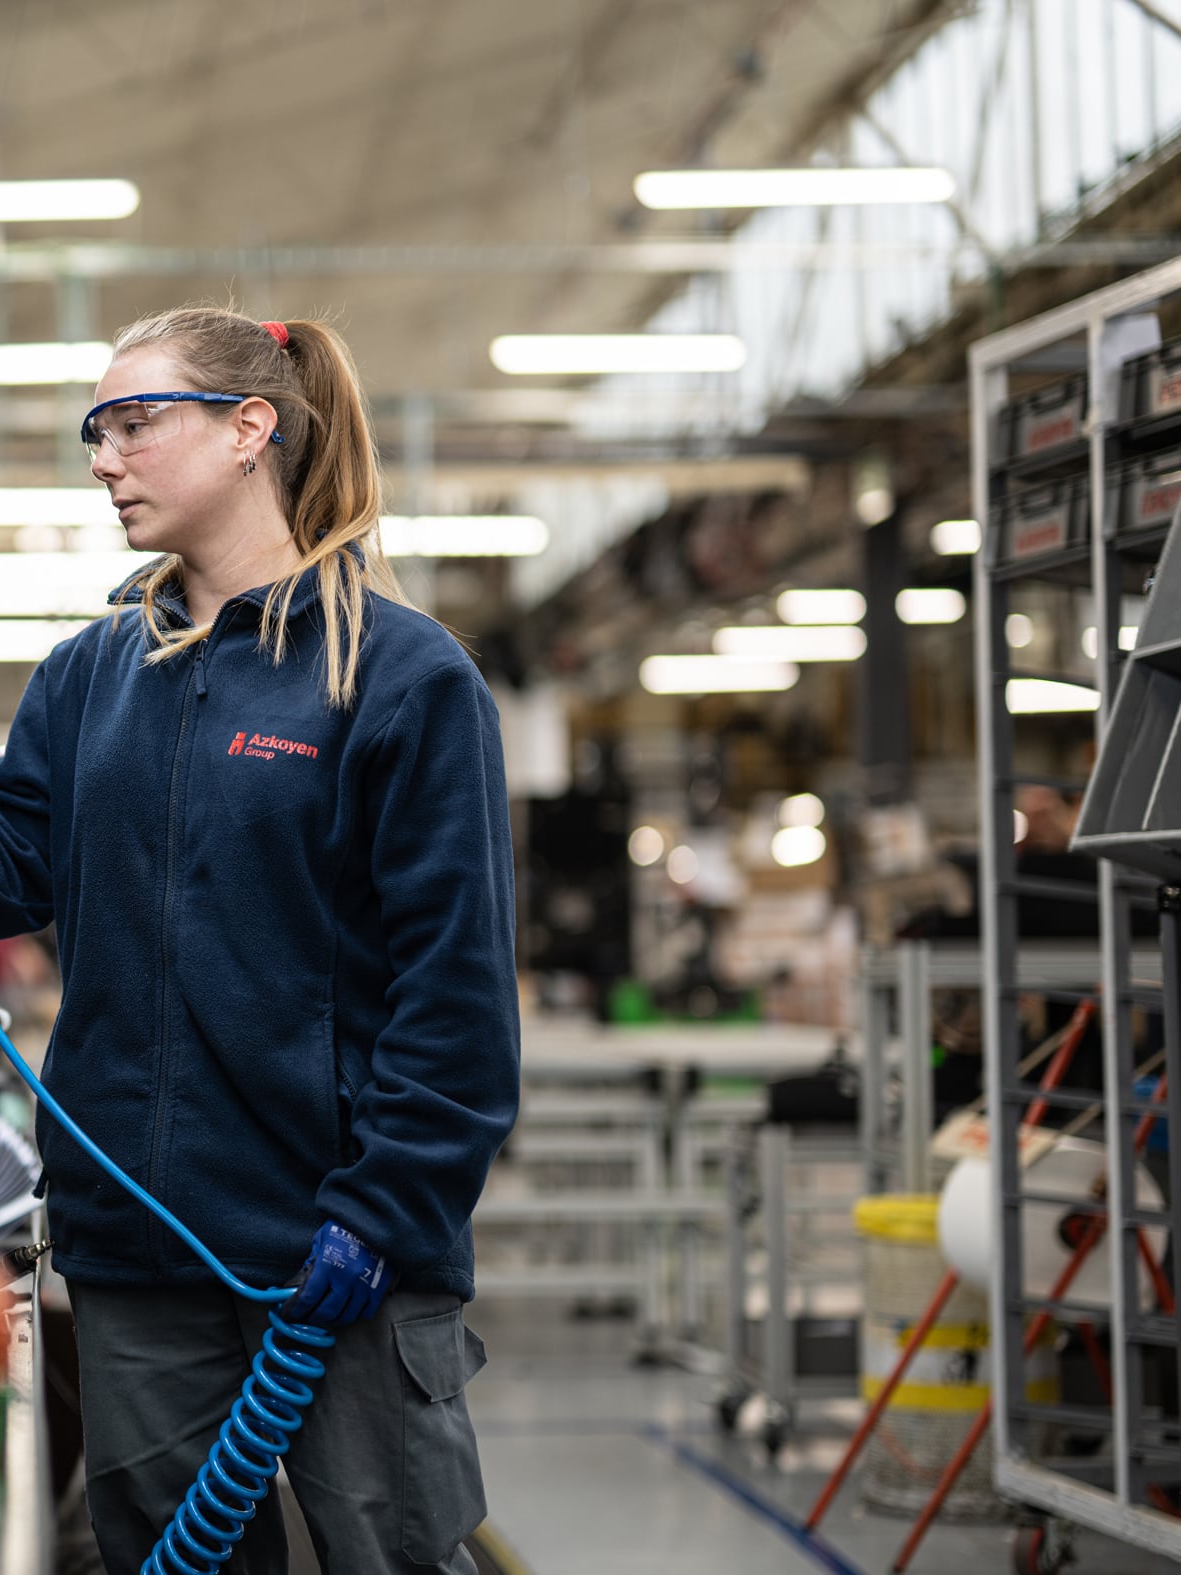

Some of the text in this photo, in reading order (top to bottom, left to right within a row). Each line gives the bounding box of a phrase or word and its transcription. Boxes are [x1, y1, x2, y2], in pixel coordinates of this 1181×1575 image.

[248, 733, 318, 758] Azkoyen
[244, 747, 275, 760] Group
[364, 1267, 372, 1278] 7
